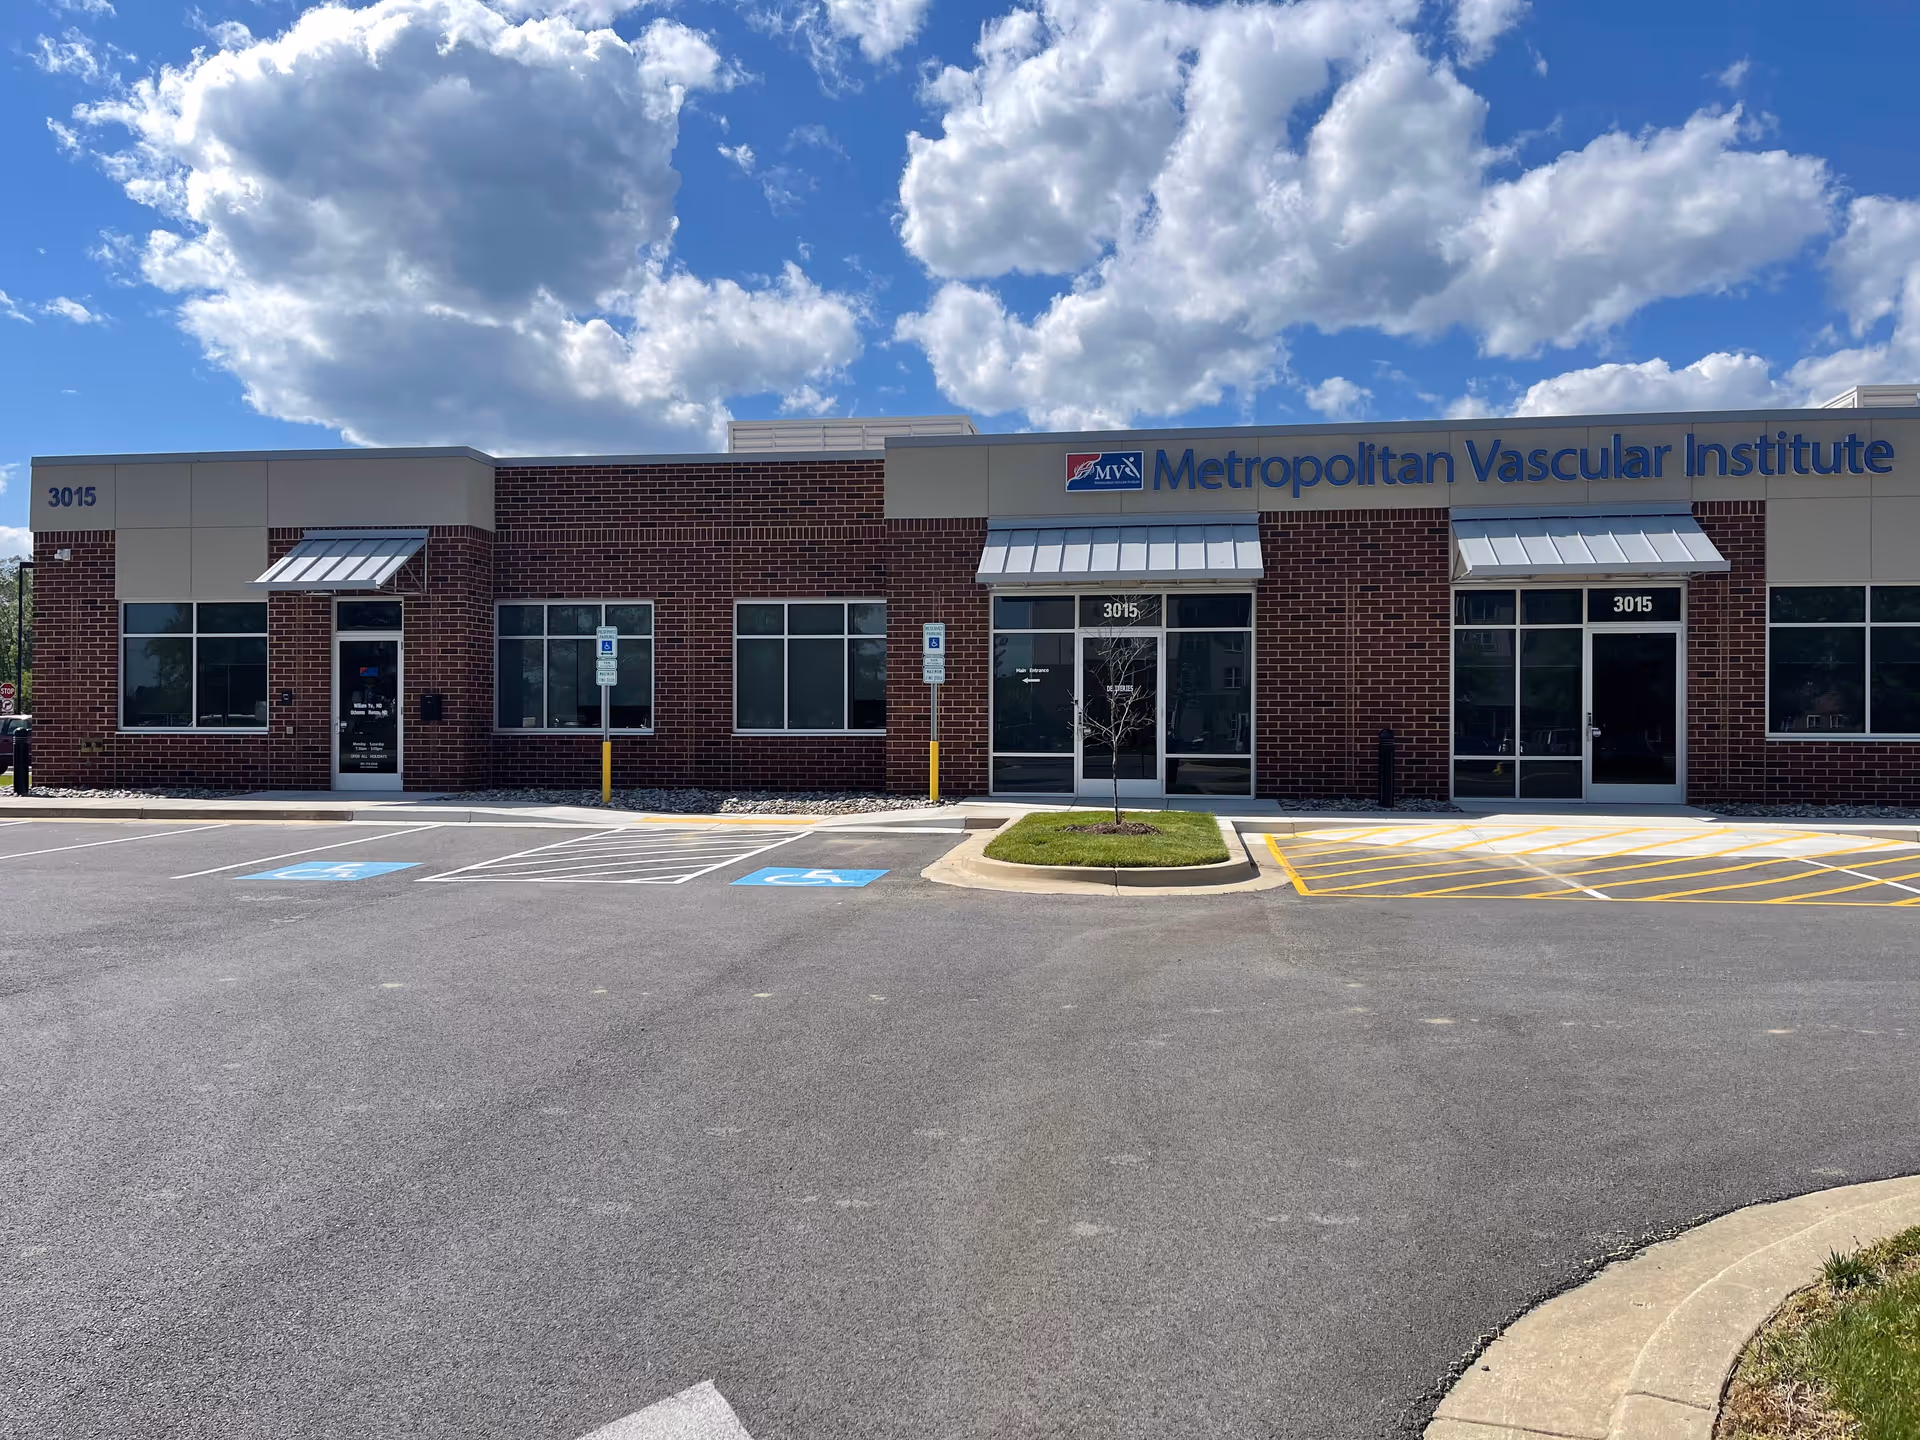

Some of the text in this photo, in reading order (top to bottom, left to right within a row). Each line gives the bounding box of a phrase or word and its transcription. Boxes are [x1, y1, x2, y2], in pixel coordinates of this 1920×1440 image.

[1153, 431, 1895, 499] Metropolitan Vascular Institute
[48, 486, 97, 508] 3015
[1103, 602, 1138, 617] 3015
[1613, 596, 1652, 612] 3015
